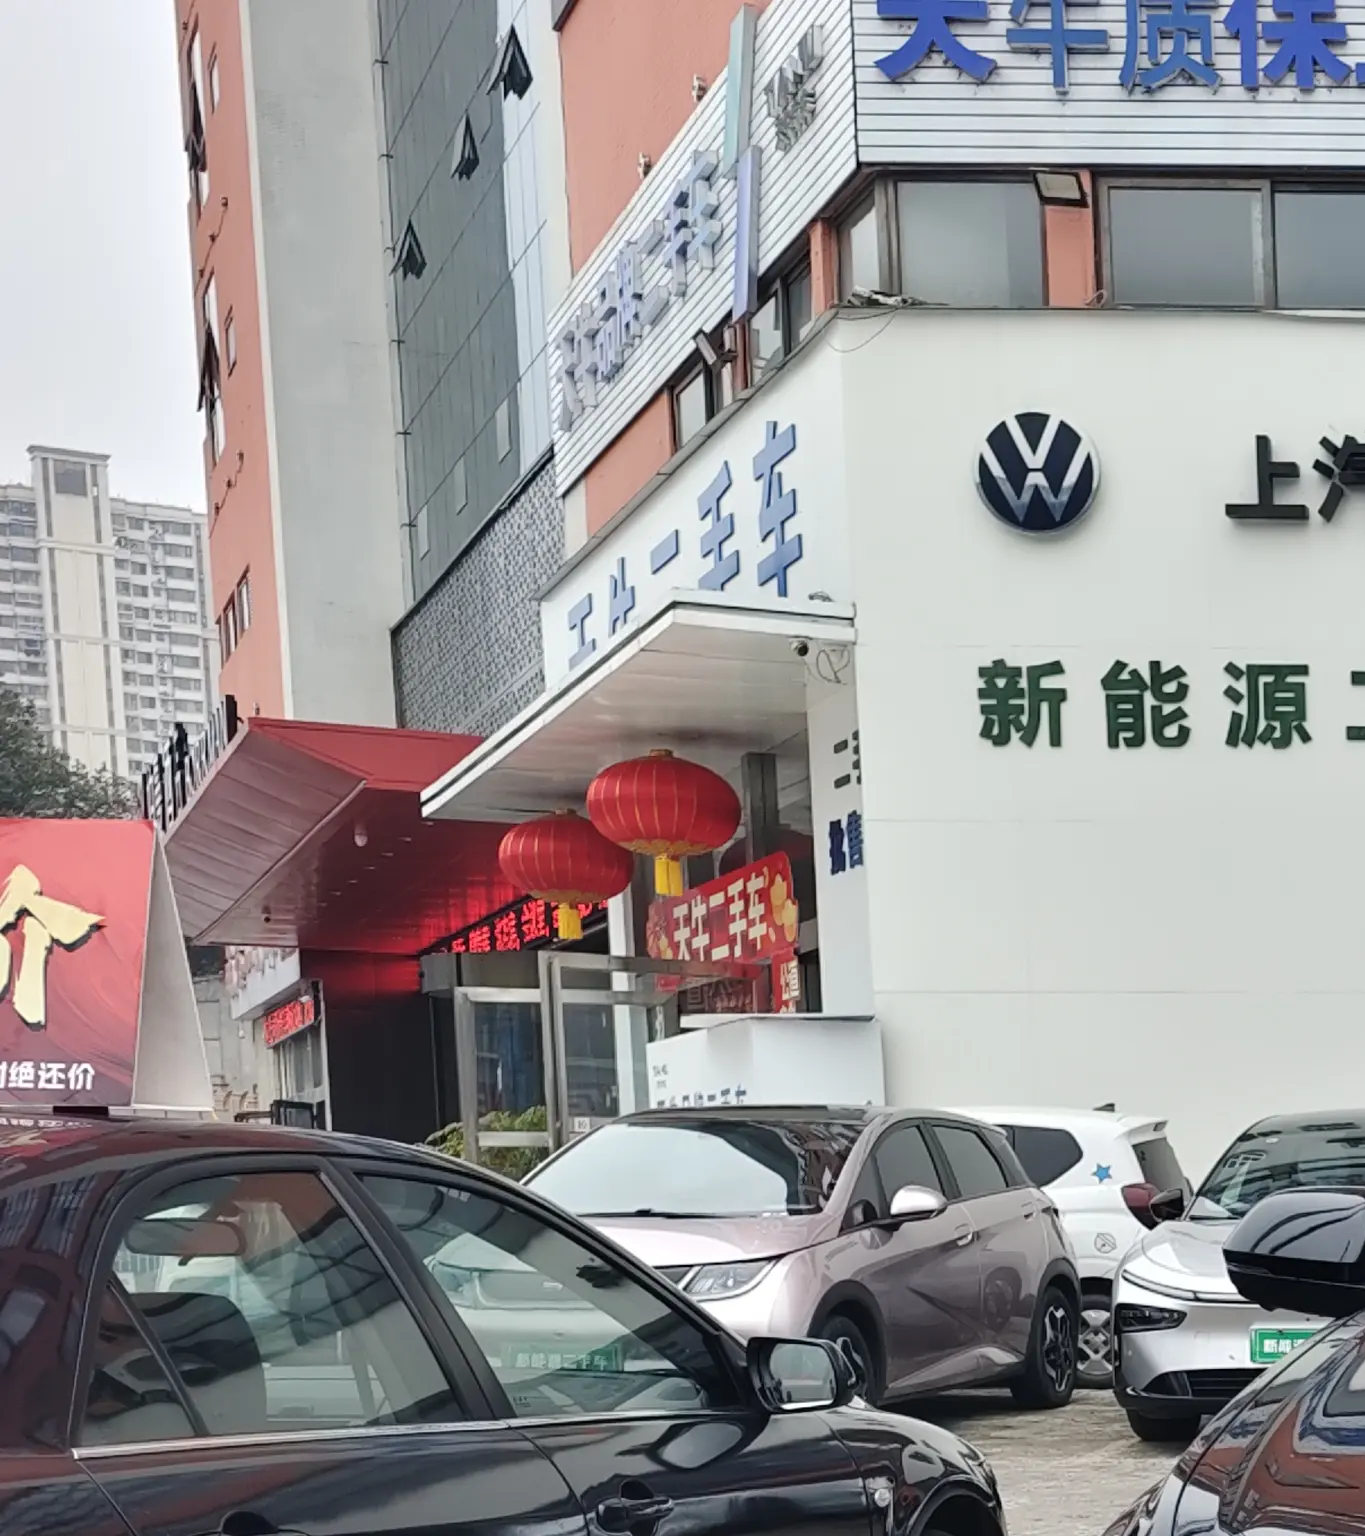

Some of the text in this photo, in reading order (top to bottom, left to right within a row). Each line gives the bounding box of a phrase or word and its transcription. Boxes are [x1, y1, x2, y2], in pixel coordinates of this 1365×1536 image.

[672, 872, 768, 963] 天牛二手车
[0, 1060, 96, 1091] 绝还价
